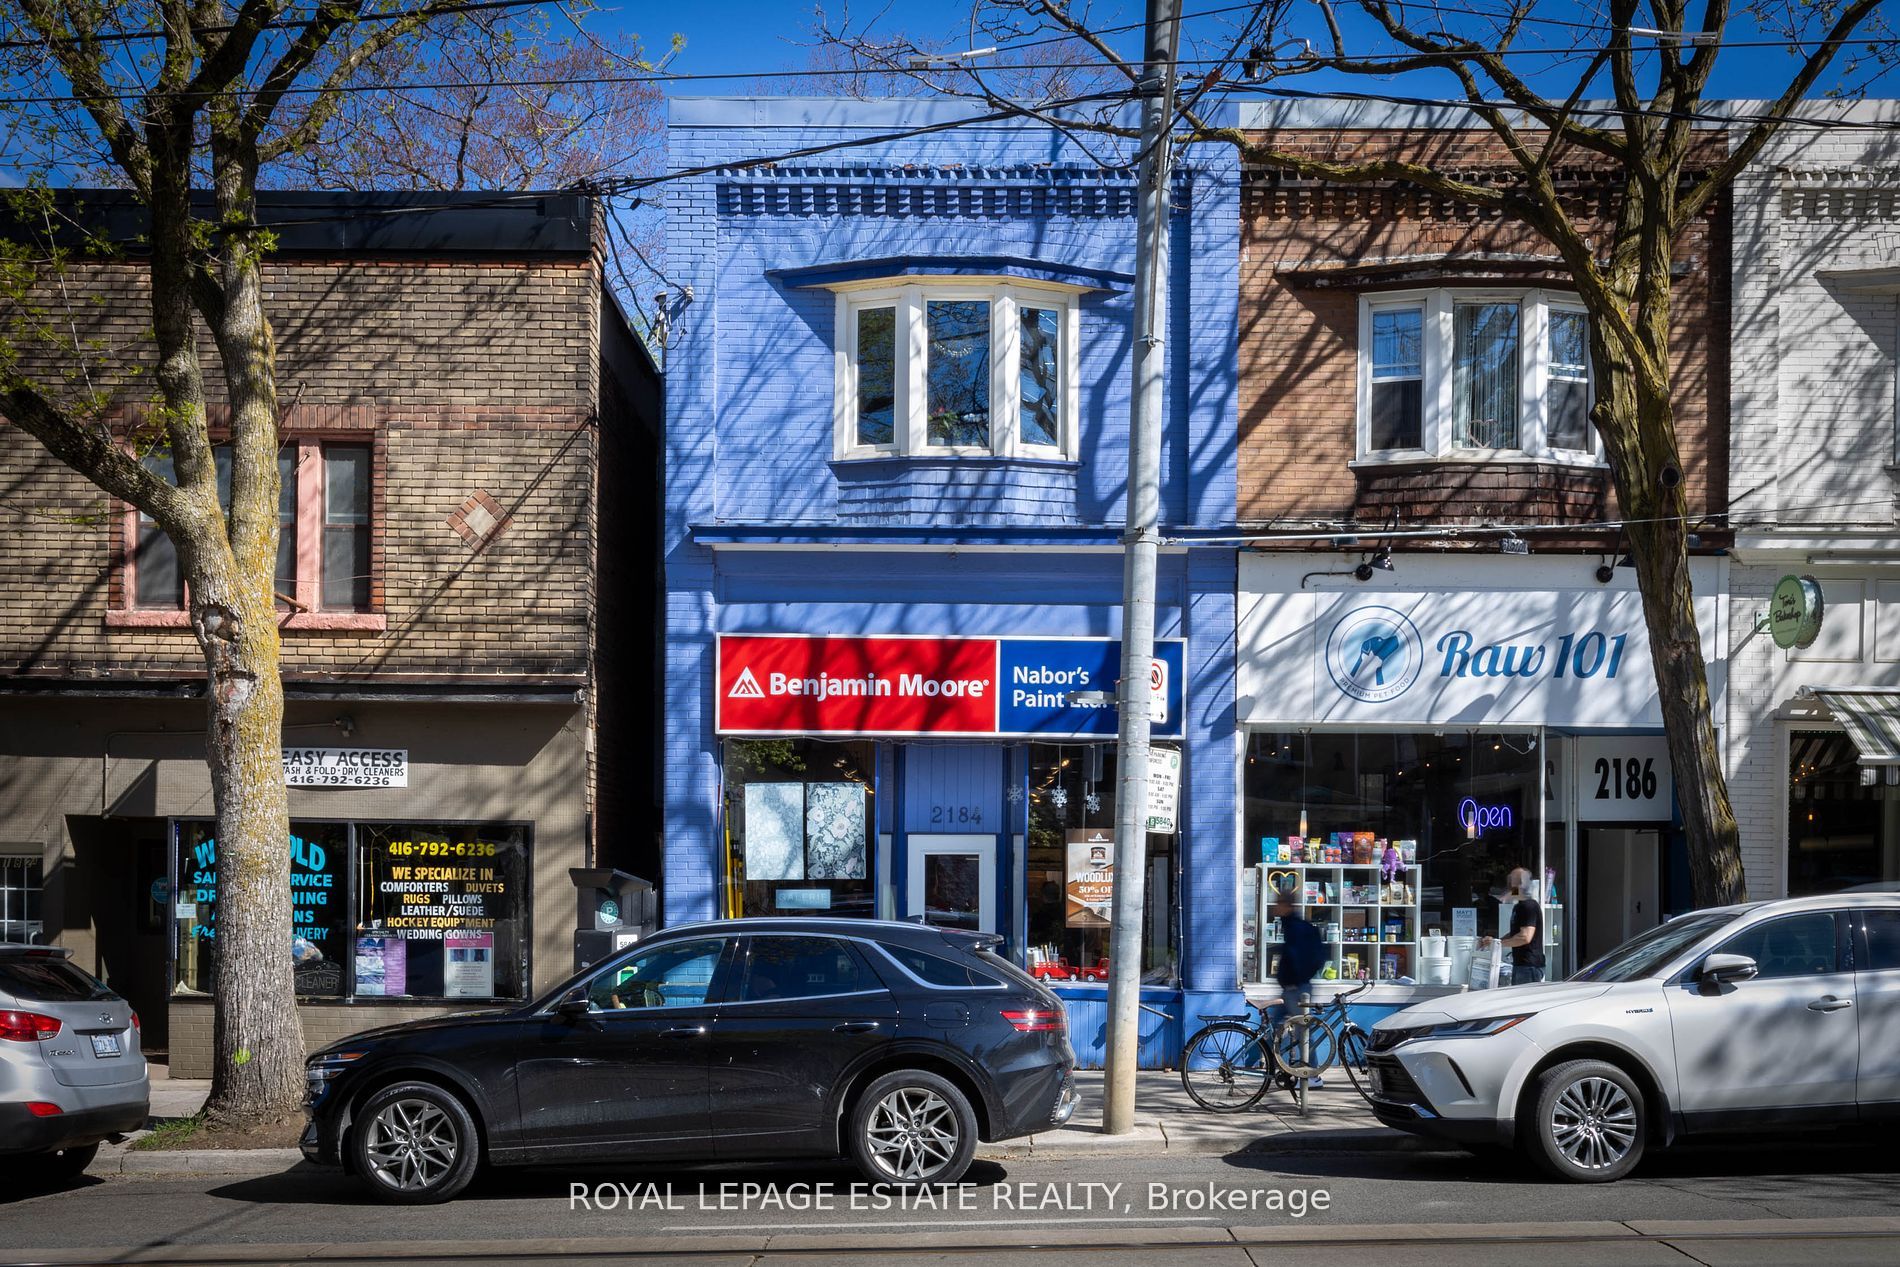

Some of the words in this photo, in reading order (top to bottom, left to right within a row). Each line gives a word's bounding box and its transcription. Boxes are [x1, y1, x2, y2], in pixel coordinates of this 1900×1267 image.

[1436, 630, 1546, 678] Raw
[1553, 631, 1628, 679] 101
[1013, 665, 1090, 685] Nabor's
[769, 672, 891, 702] Benjamin
[1340, 677, 1371, 698] PREMIUM
[1373, 690, 1388, 699] PET
[1390, 677, 1410, 695] FOOD
[1013, 689, 1065, 708] Paint
[336, 751, 403, 768] ACCESS
[283, 766, 301, 775] ASH
[363, 767, 404, 777] CLEANERS
[1594, 757, 1657, 800] 2186
[290, 775, 390, 786] 416-792-6236
[1459, 798, 1512, 836] Open
[389, 841, 496, 857] 416-792-6236
[290, 873, 333, 887] RVICE
[392, 866, 412, 880] WE
[414, 867, 477, 881] SPECIALIZE
[481, 868, 494, 881] IN
[380, 881, 449, 893] COMFORTERS
[465, 882, 504, 894] DUVETS
[1100, 885, 1113, 894] OF
[403, 893, 431, 905] RUGS
[442, 894, 483, 905] PILLOWS
[387, 917, 429, 928] HOCKEY
[397, 929, 443, 940] WEDDING
[445, 929, 482, 940] GOWNS
